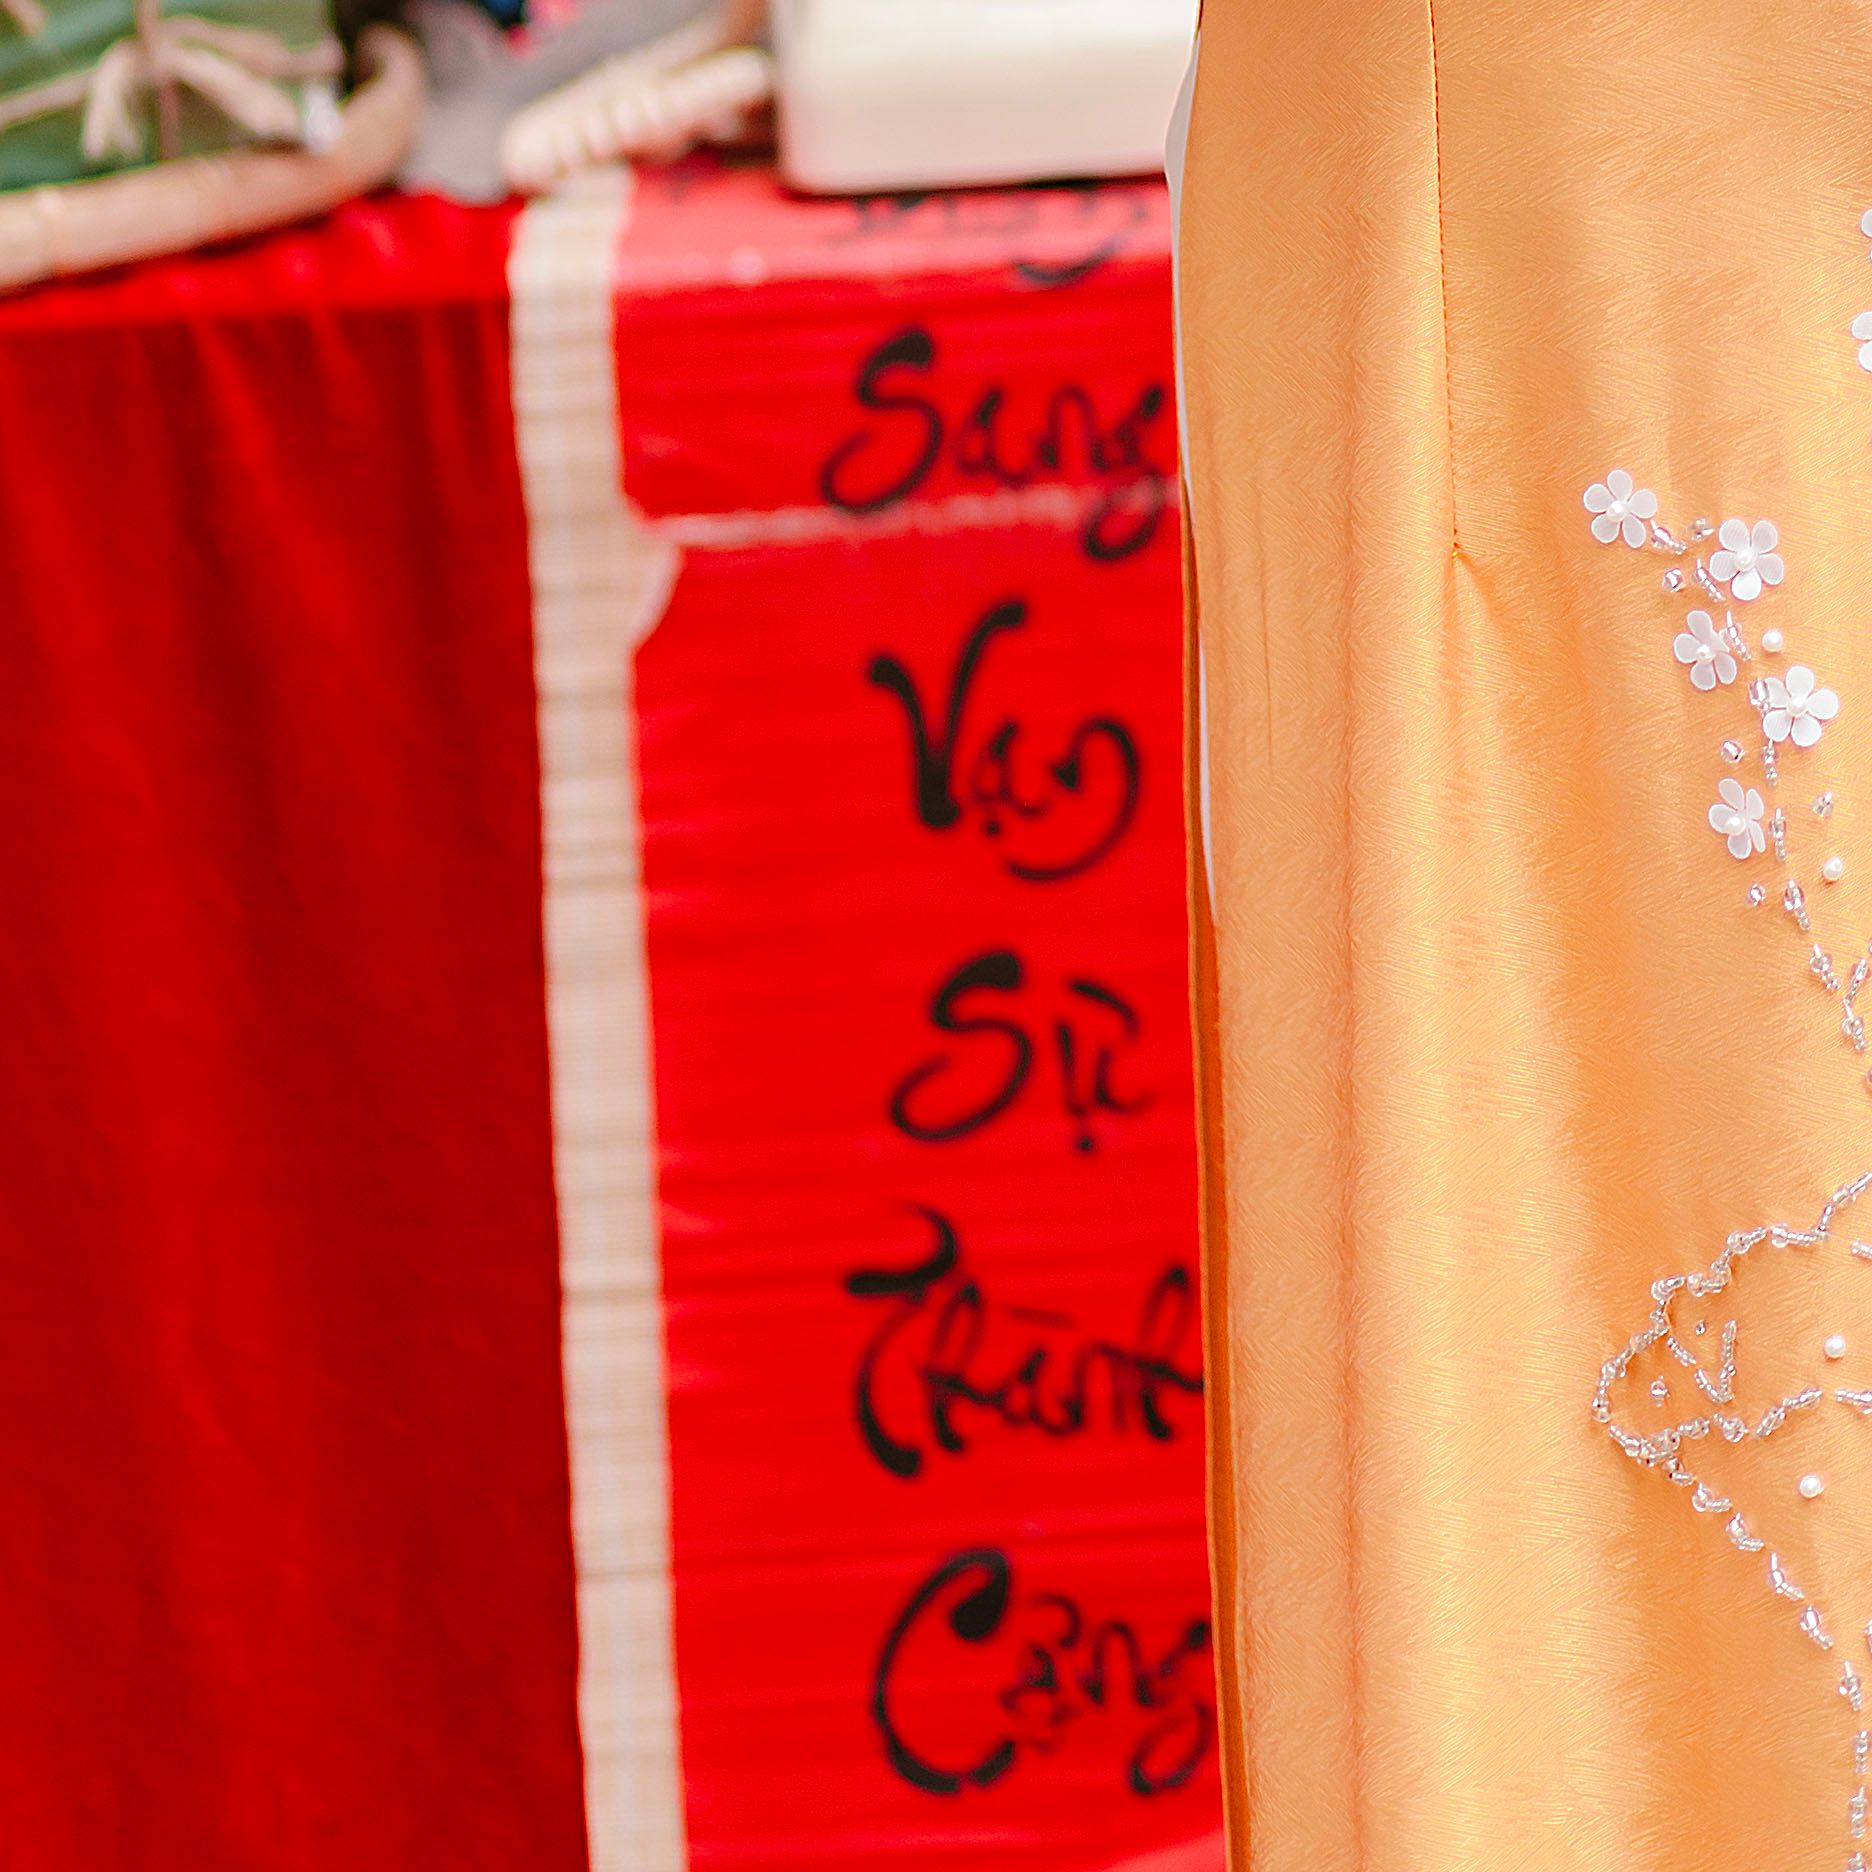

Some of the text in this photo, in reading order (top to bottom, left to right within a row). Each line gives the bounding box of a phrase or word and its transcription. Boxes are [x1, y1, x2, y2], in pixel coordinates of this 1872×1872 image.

[818, 325, 1167, 565] Sang
[865, 597, 1142, 884] Vạn
[887, 948, 1153, 1154] Sự
